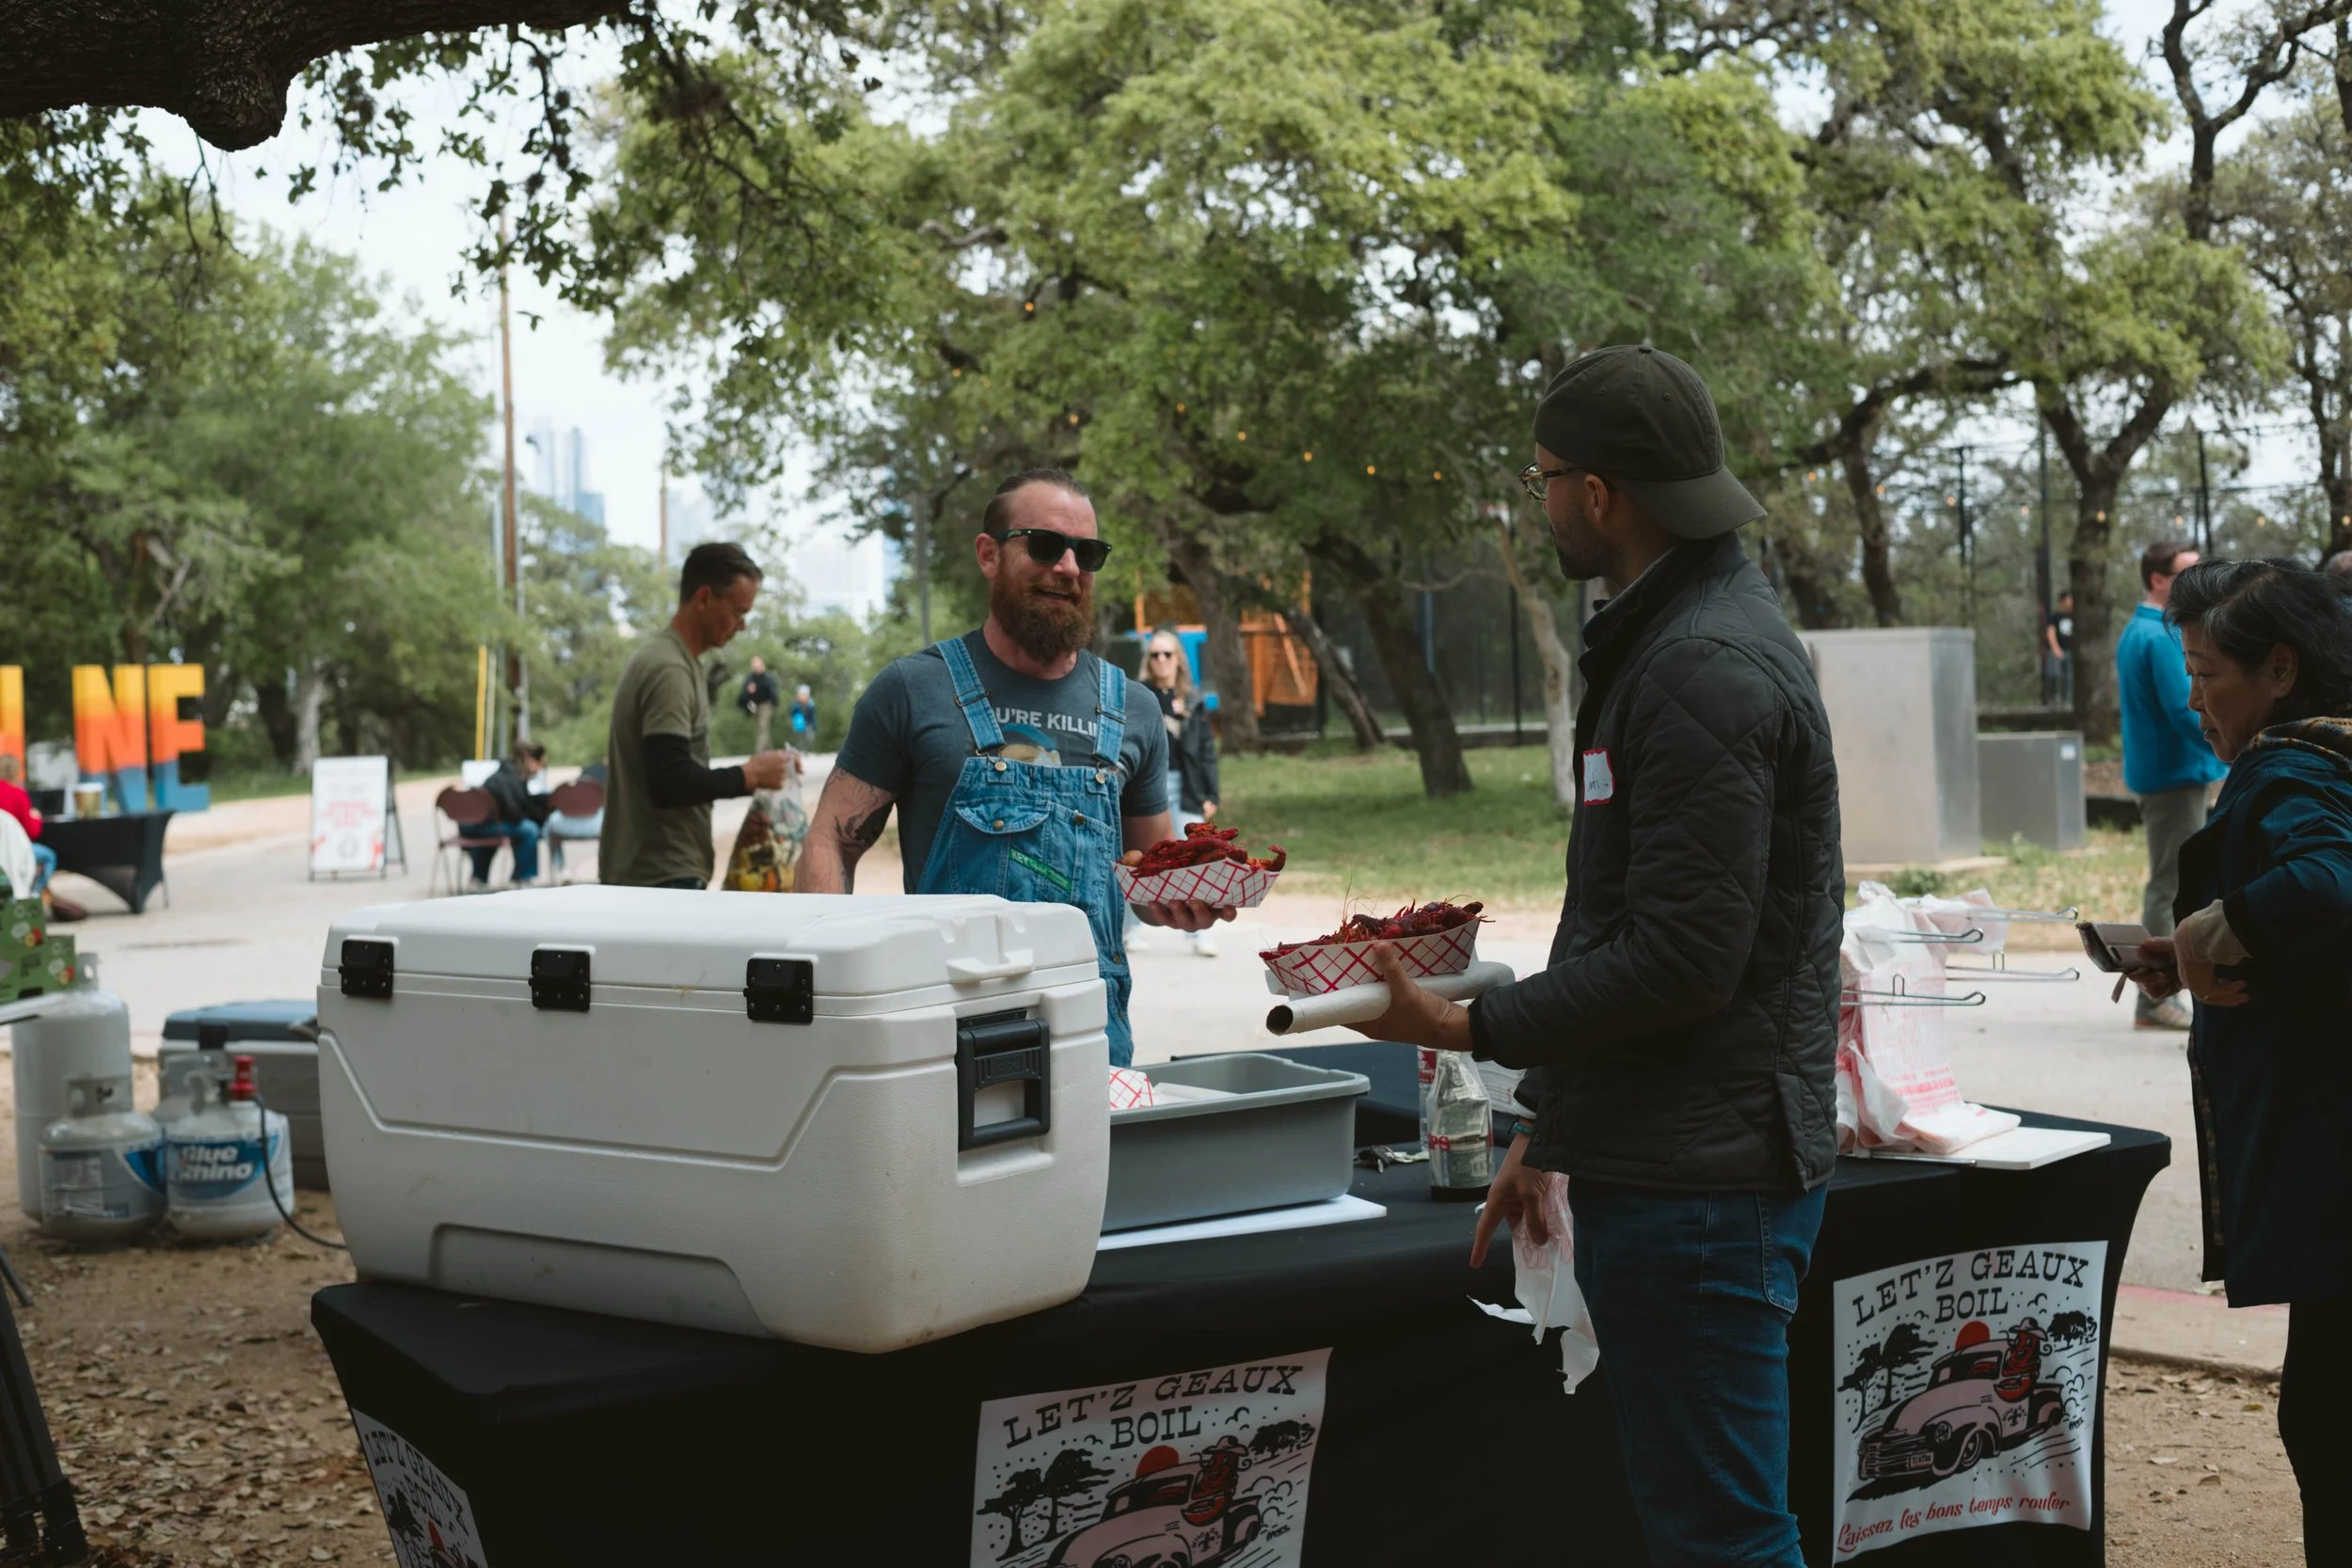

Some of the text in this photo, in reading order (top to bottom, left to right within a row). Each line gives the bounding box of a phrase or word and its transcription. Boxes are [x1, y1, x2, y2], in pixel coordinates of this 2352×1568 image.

[994, 707, 1041, 728] U'RE
[1011, 848, 1029, 864] KEY
[1851, 1250, 2090, 1326] LET'Z GEAUX
[1934, 1287, 2010, 1323] BOIL
[1003, 1366, 1303, 1449] LET'Z GEAUX
[1110, 1405, 1201, 1449] BOIL
[1836, 1520, 1894, 1553] Laissez
[1926, 1501, 1963, 1520] bons
[1969, 1496, 2013, 1515] temps
[2018, 1490, 2071, 1512] rouler
